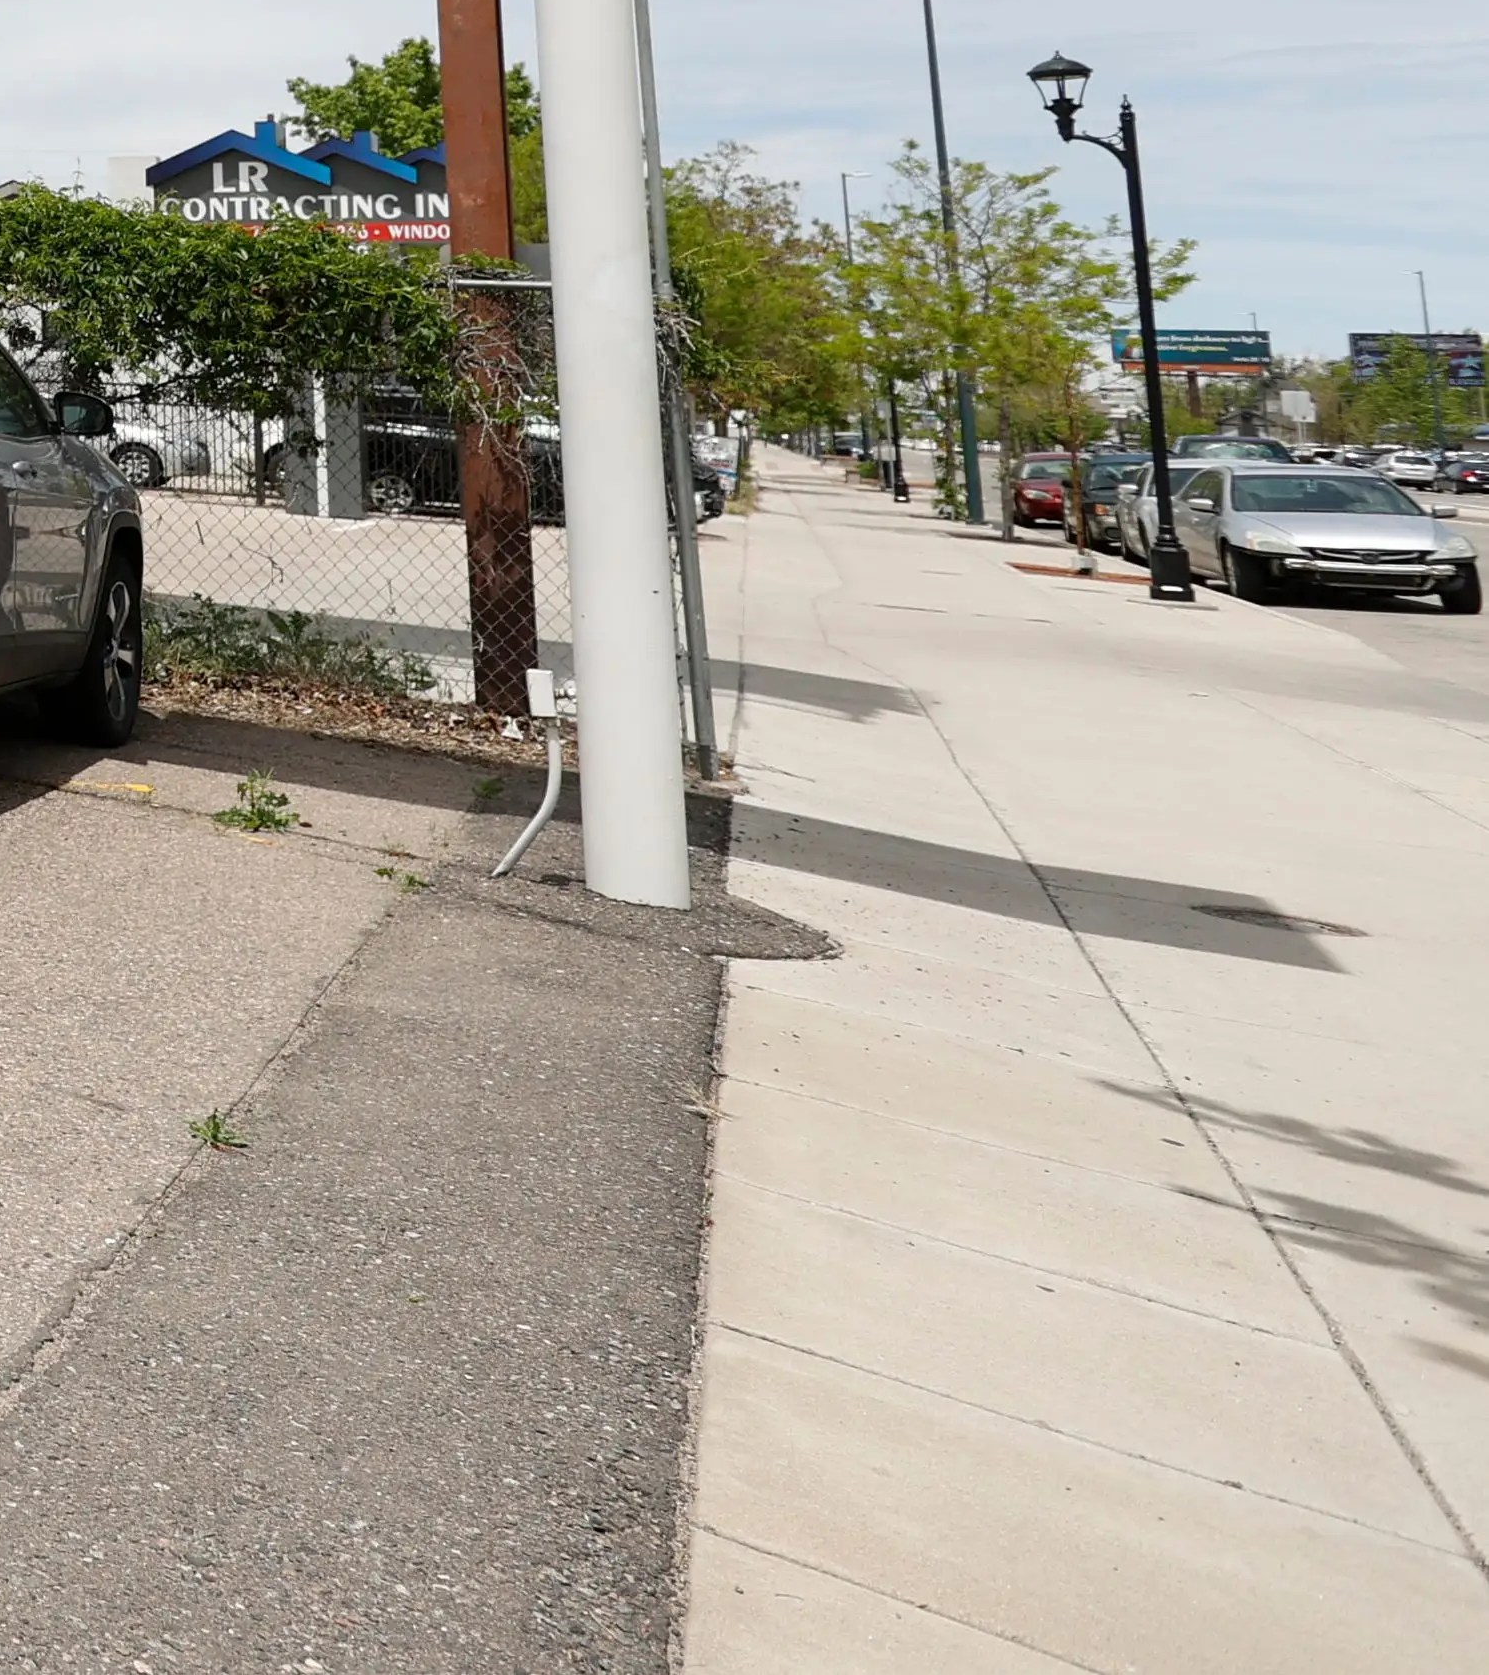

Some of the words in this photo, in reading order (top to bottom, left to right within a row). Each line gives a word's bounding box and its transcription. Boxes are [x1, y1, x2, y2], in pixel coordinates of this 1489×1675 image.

[212, 161, 269, 194] LR
[414, 192, 450, 219] IN
[388, 224, 450, 240] WINDO
